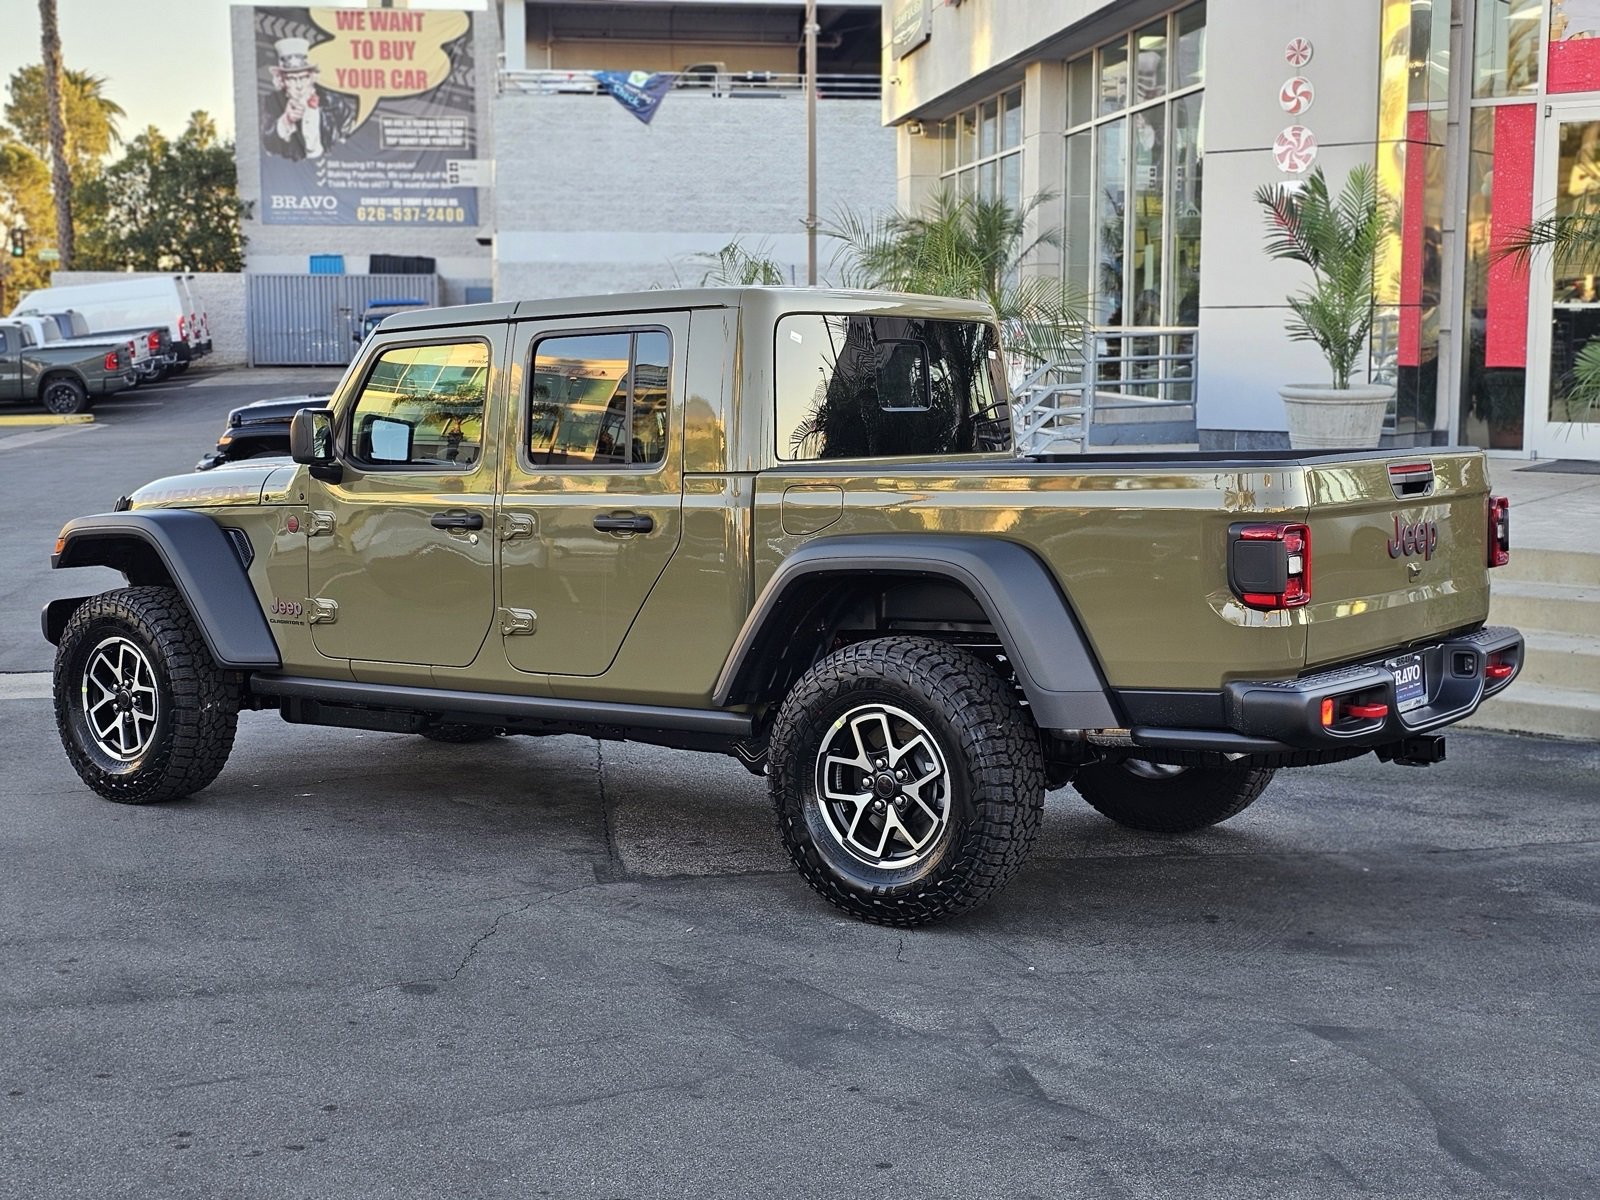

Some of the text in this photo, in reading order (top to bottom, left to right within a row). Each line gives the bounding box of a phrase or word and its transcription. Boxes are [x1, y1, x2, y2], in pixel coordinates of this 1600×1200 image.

[336, 11, 425, 32] WE WANT
[350, 40, 416, 60] TO BUY
[336, 68, 428, 89] YOUR CAR
[271, 195, 337, 209] BRAVO
[356, 207, 465, 222] 626-537-2400
[140, 485, 250, 501] RUBICON
[1387, 514, 1438, 561] Jeep
[271, 597, 303, 618] Jeep
[1393, 664, 1420, 685] RAVO
